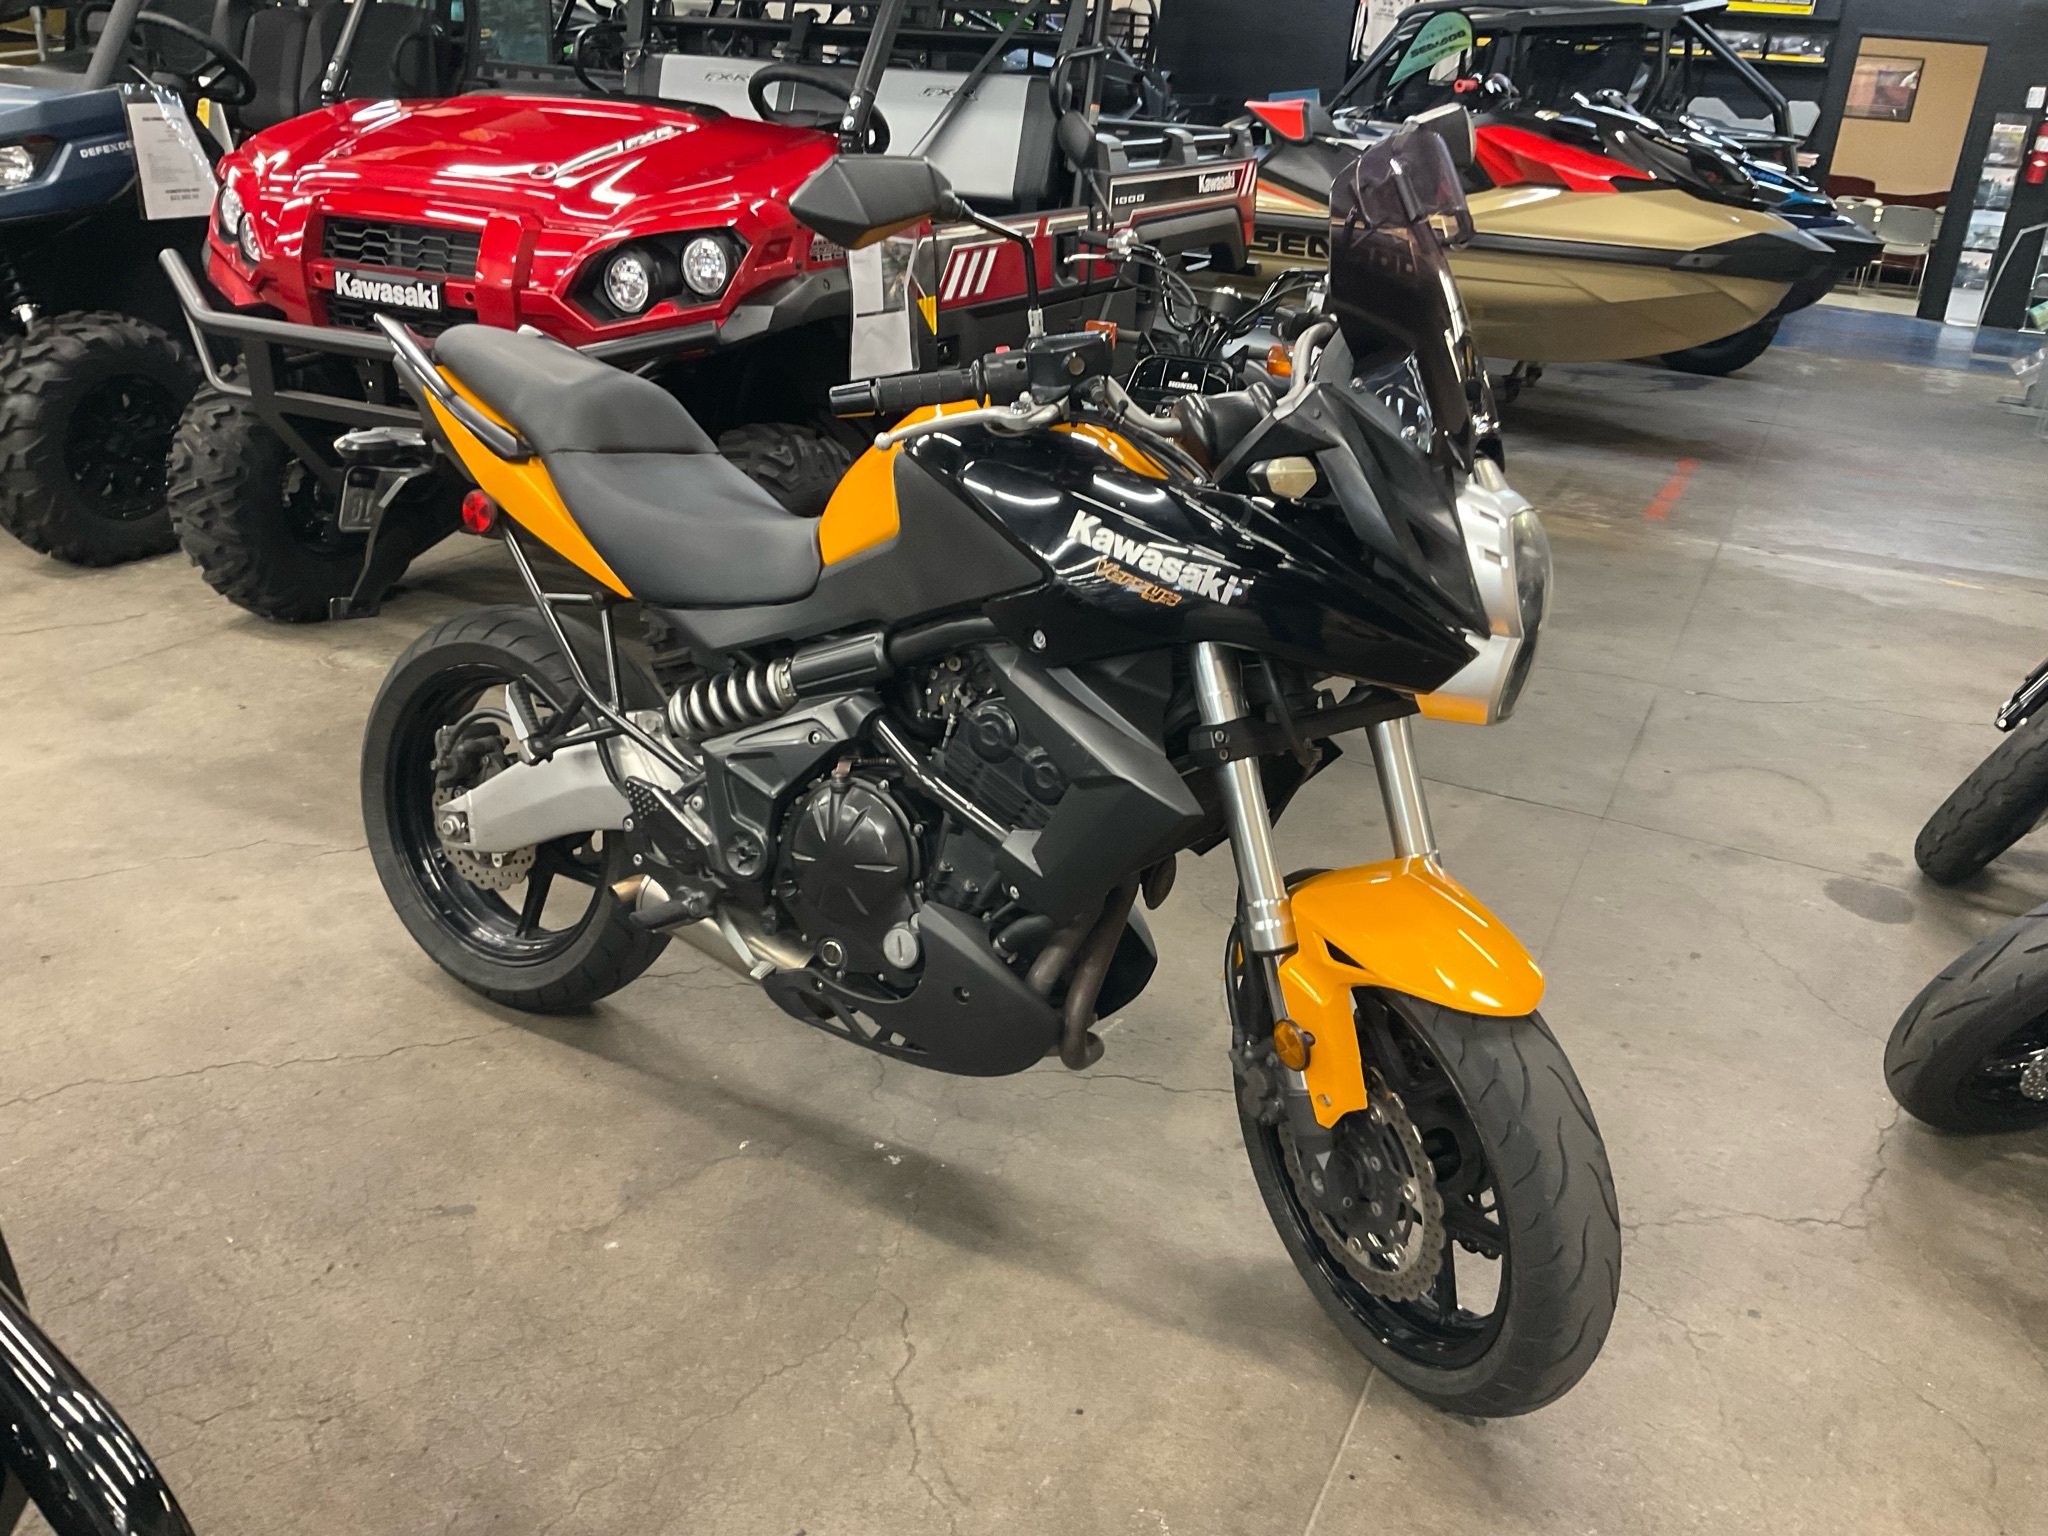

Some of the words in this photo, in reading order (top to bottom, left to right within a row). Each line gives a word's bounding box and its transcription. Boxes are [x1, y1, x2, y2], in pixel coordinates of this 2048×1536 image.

[79, 140, 134, 159] DEFENDE
[1198, 171, 1236, 194] Kawasaki
[1115, 193, 1145, 206] 1000
[334, 270, 440, 310] Kawasaki
[1167, 380, 1199, 392] HONDA
[1066, 509, 1239, 605] Kawasaki
